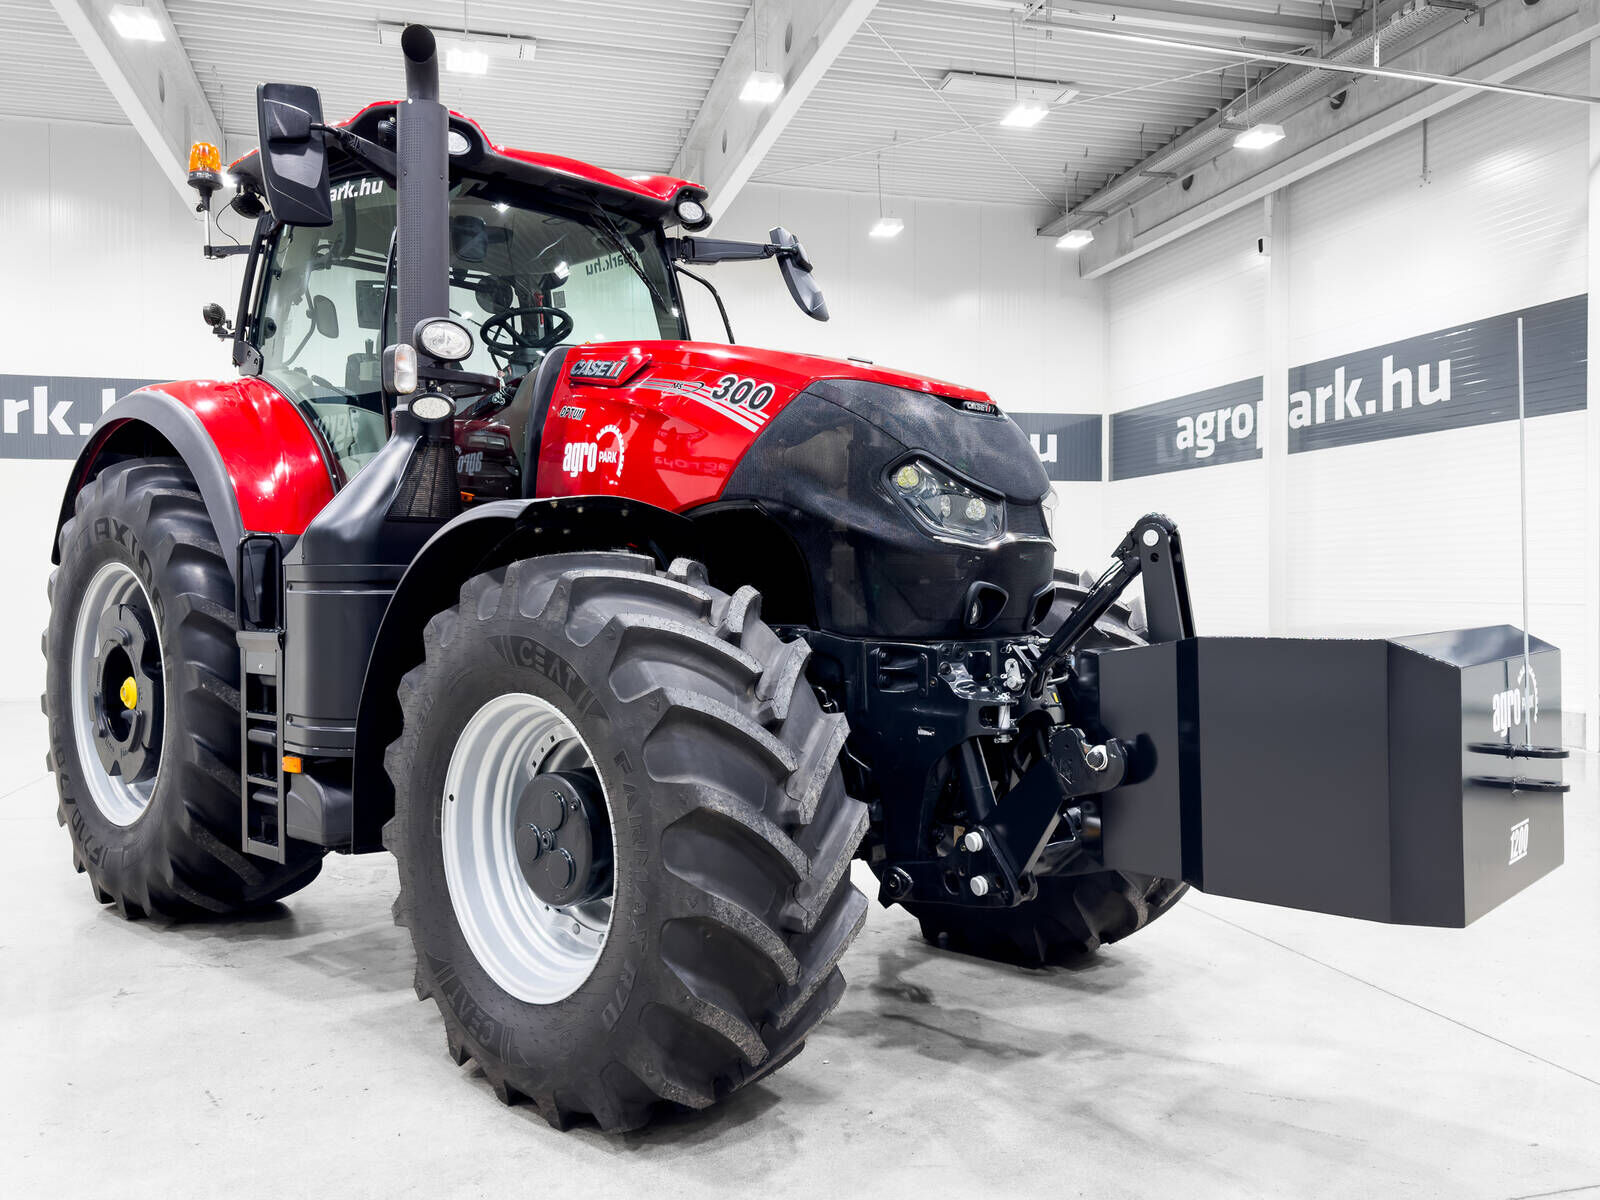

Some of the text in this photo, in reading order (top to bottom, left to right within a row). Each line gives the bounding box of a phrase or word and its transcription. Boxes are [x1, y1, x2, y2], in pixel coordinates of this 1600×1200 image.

[560, 406, 586, 421] OPTUM
[710, 374, 776, 411] 300
[1176, 355, 1451, 459] agroark.hu
[562, 442, 618, 477] agro PARK
[519, 640, 578, 694] CEAT
[1492, 687, 1521, 738] agro
